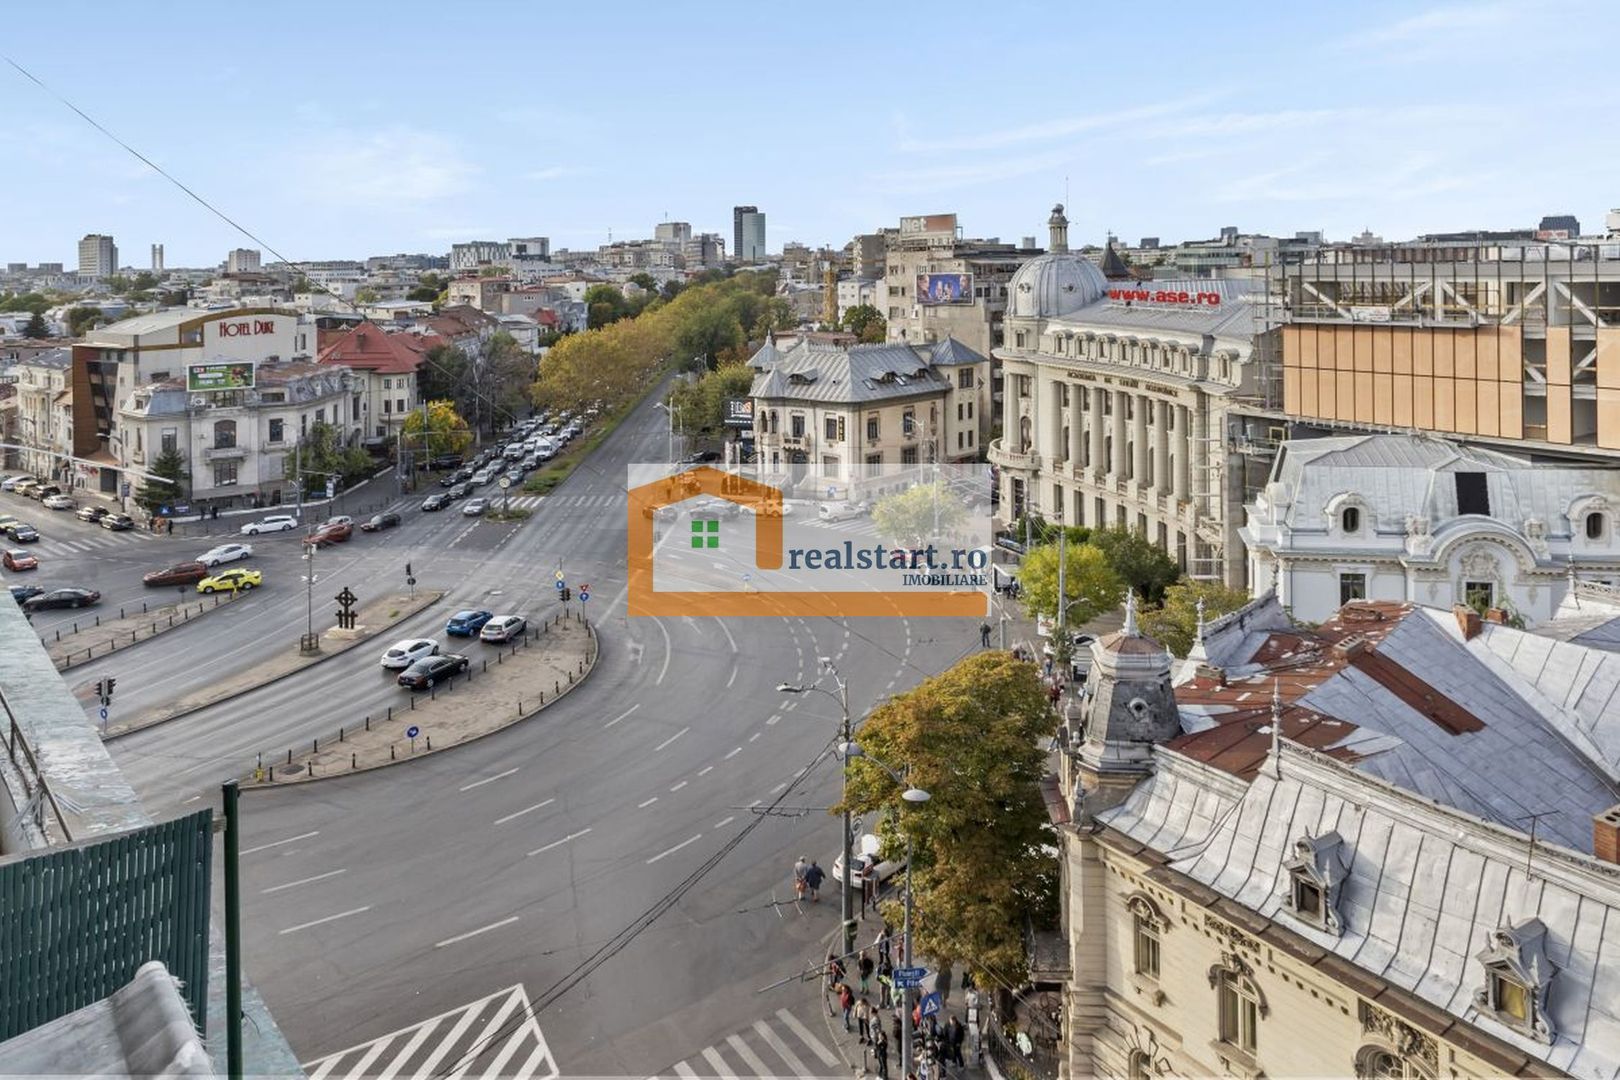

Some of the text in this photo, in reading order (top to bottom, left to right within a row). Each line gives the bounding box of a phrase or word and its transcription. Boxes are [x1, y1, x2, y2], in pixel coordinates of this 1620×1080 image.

[901, 217, 927, 233] Net
[1108, 288, 1220, 305] www.ase.ro
[219, 321, 251, 337] HOTEL
